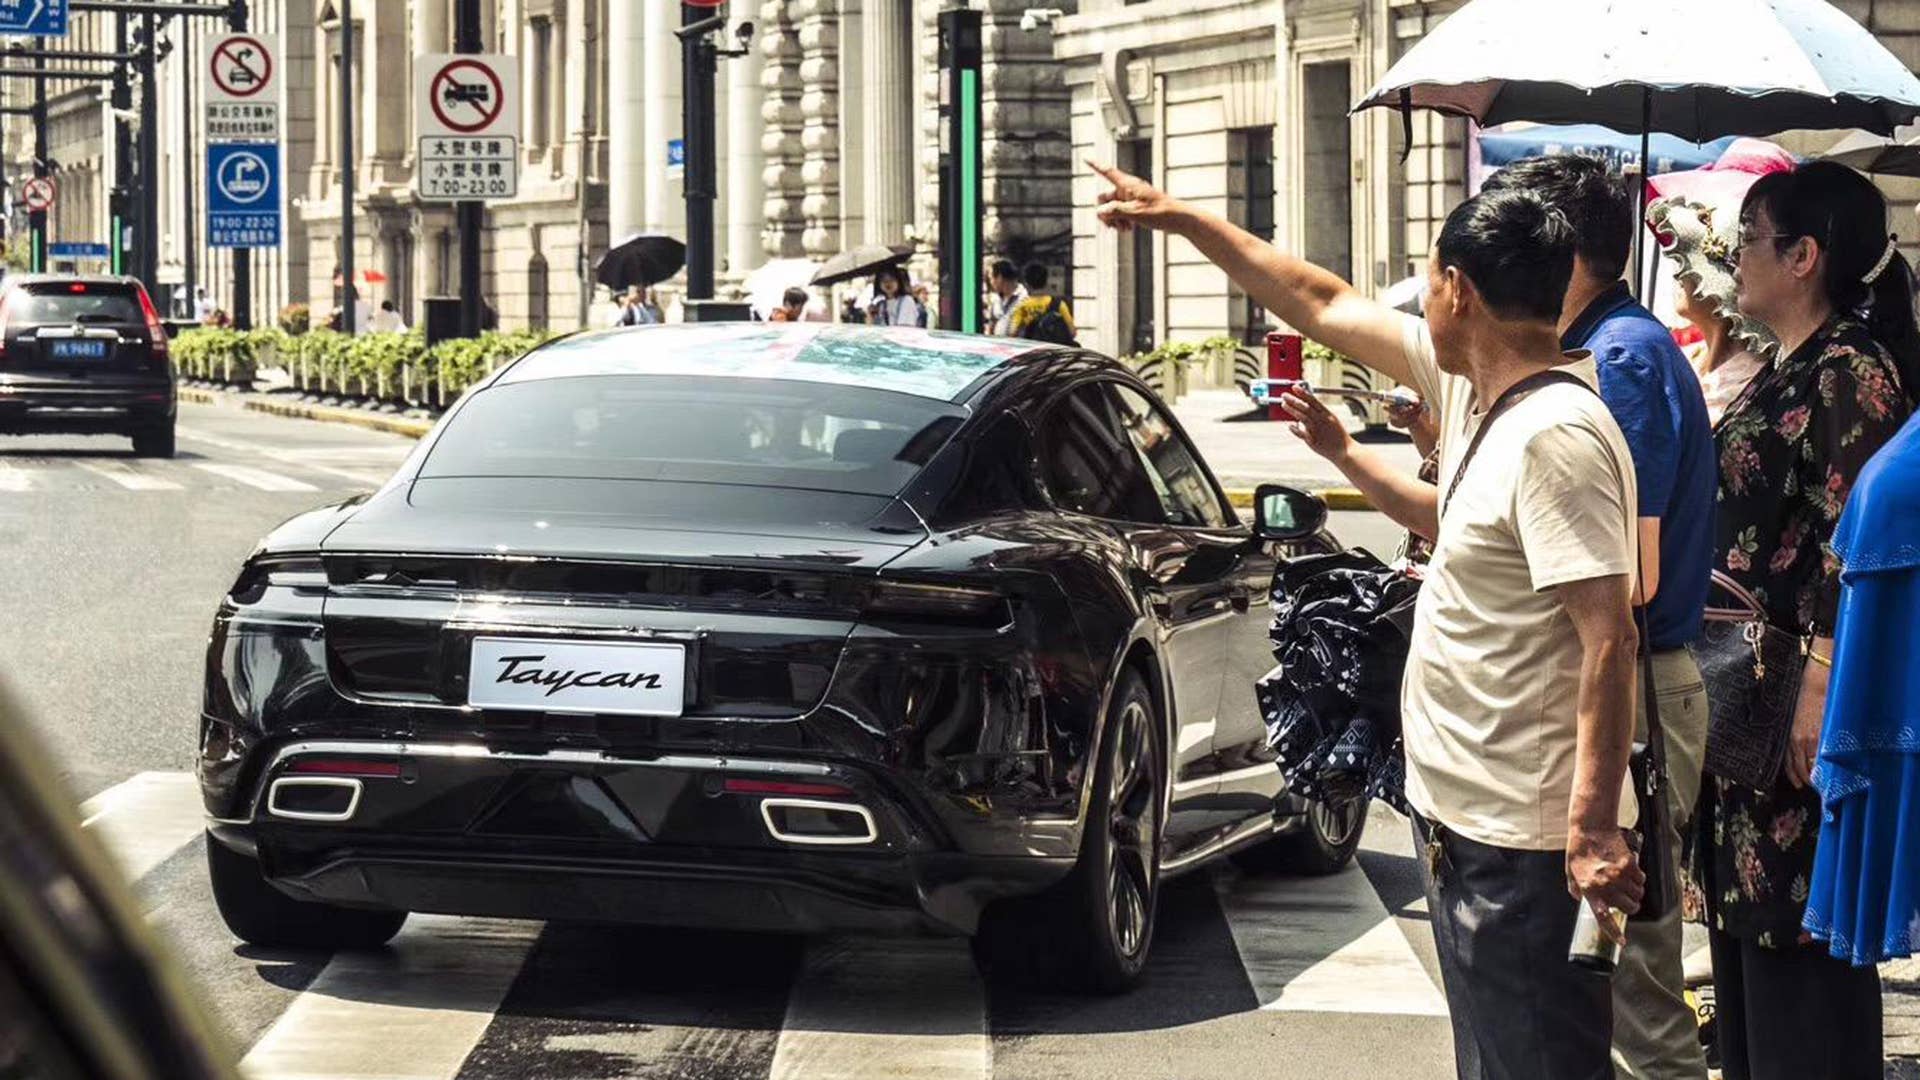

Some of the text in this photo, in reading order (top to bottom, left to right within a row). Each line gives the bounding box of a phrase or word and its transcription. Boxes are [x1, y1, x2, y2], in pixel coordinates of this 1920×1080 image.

[434, 141, 500, 155] 大型号牌
[435, 163, 501, 177] 小型号牌
[496, 656, 662, 697] Taycan
